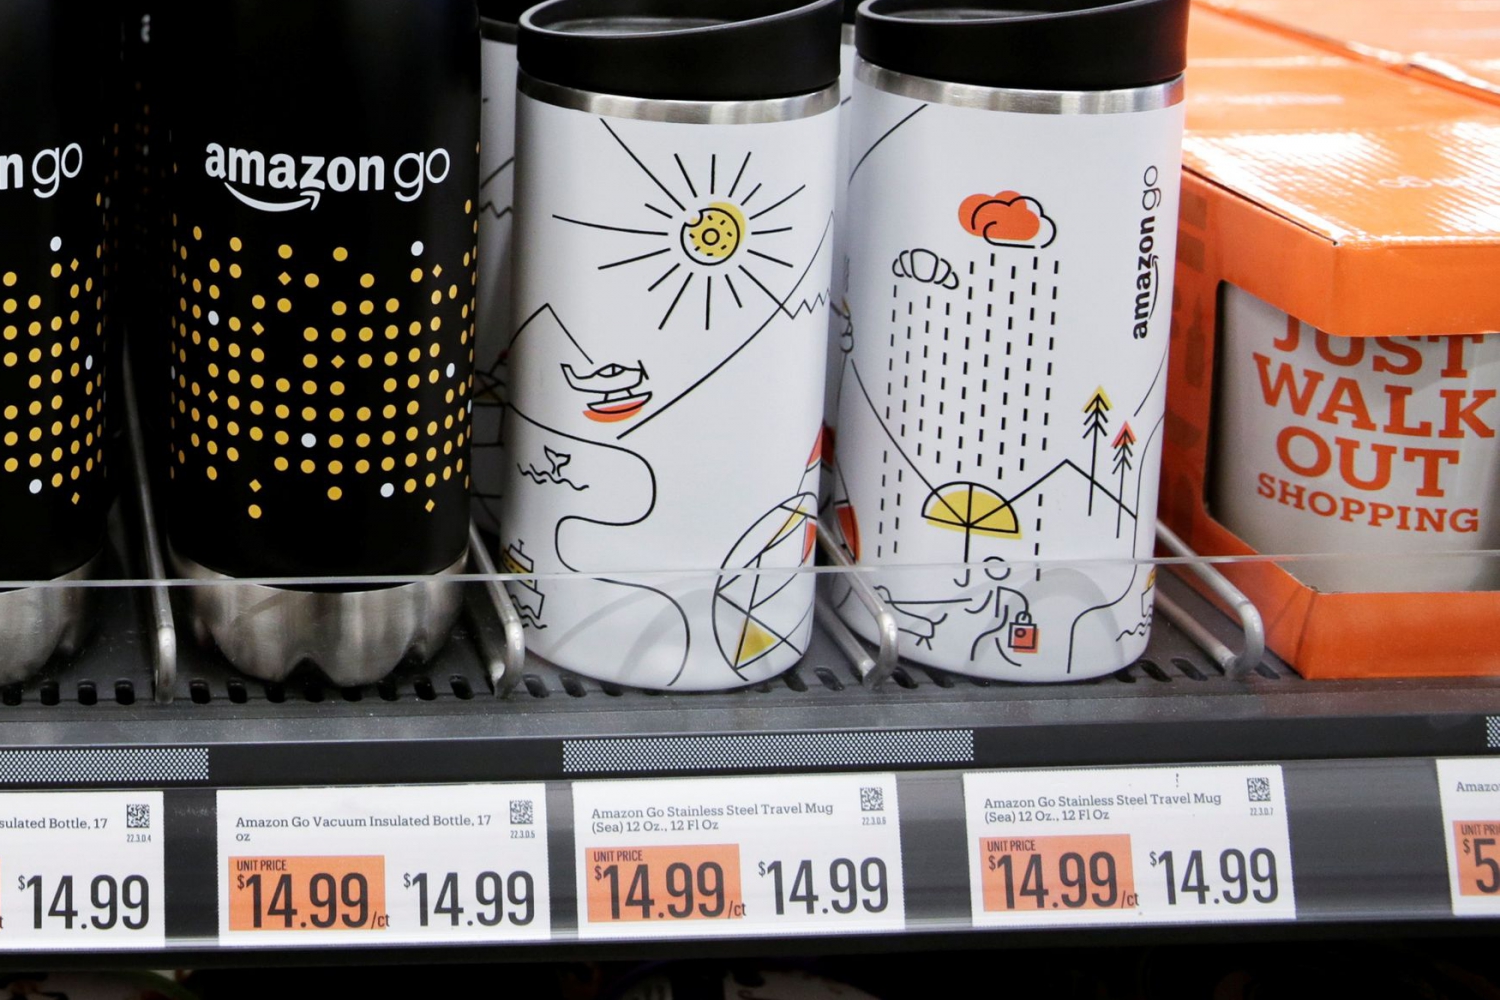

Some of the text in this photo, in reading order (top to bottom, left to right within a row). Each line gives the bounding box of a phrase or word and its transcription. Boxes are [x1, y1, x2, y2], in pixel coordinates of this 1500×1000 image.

[32, 142, 83, 198] go
[205, 142, 450, 202] amazon go
[1132, 165, 1161, 340] amazon go
[1252, 352, 1497, 439] WALK
[1276, 425, 1459, 497] OUT
[1257, 472, 1480, 533] SHOPPING
[49, 817, 90, 831] Bottle,
[93, 817, 108, 829] 17
[591, 802, 834, 820] Amazon Go Stainless Steel Travel Mug
[591, 821, 624, 834] (Sea)
[626, 821, 641, 832] 12
[670, 820, 685, 831] 12
[687, 819, 700, 830] Fl
[702, 819, 719, 831] Oz
[593, 850, 643, 863] UNIT PRICE
